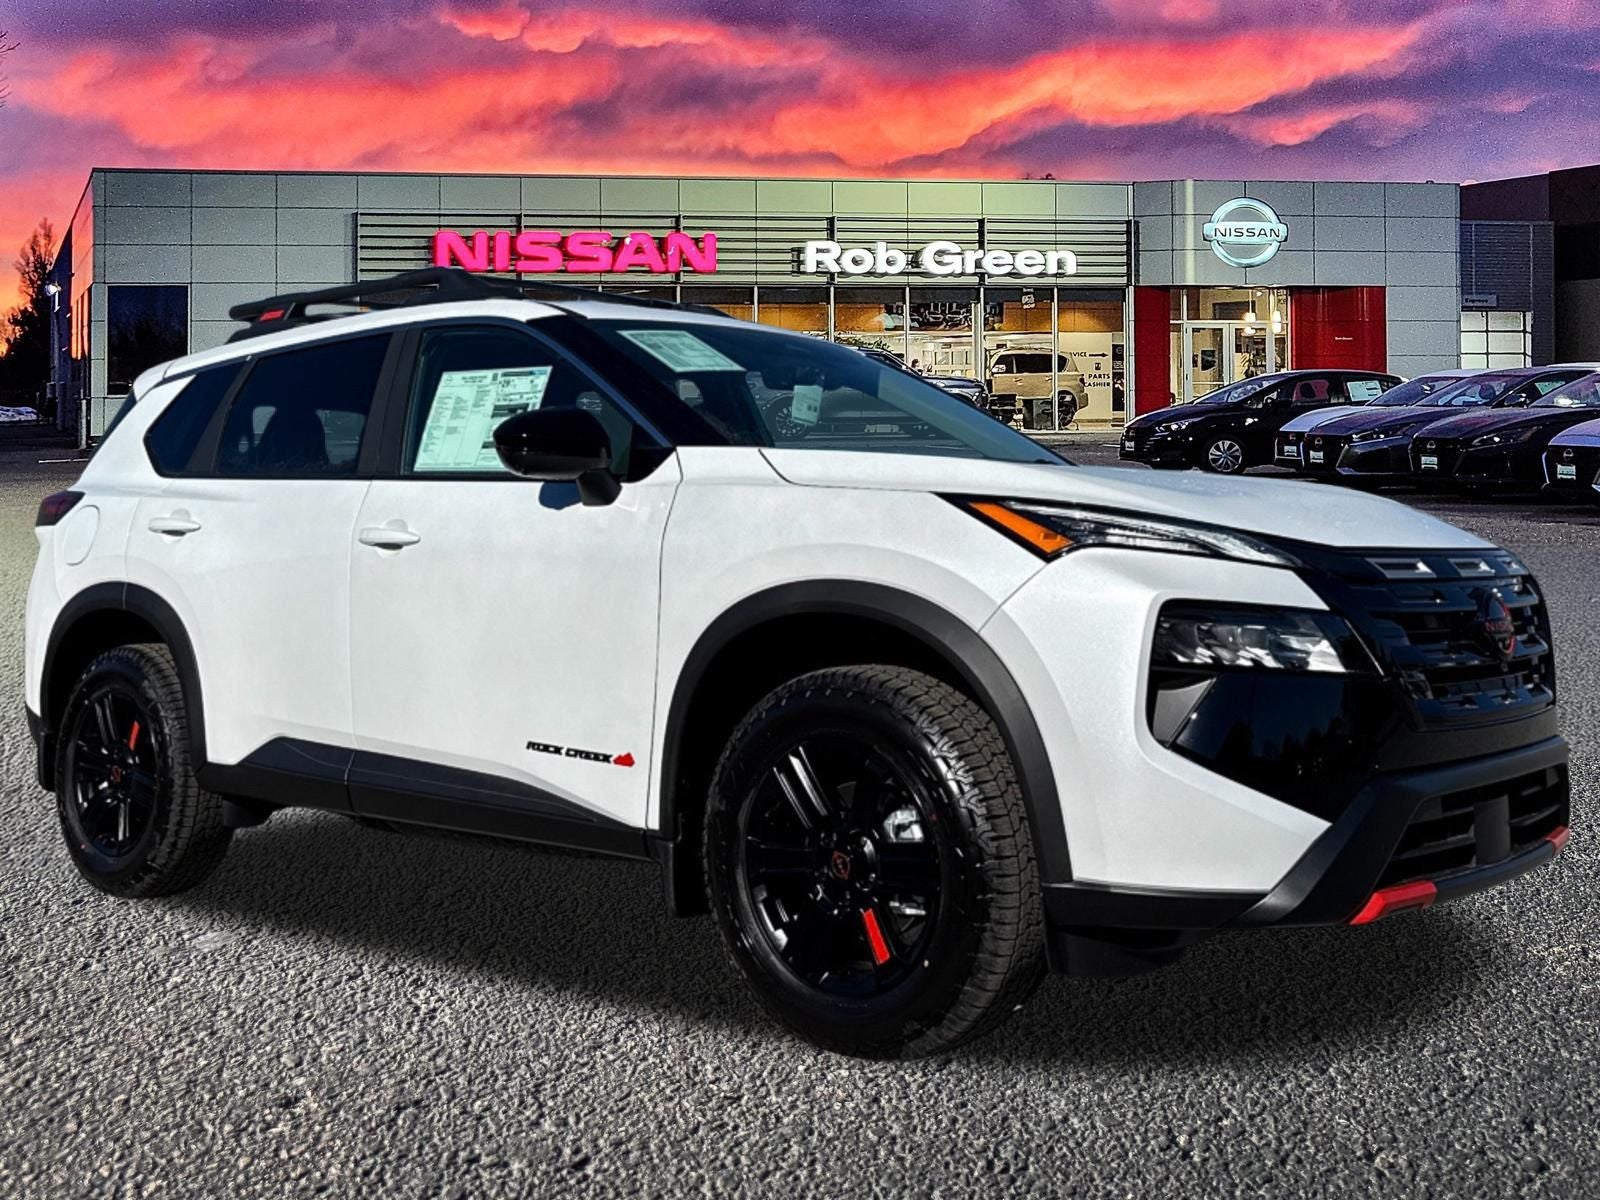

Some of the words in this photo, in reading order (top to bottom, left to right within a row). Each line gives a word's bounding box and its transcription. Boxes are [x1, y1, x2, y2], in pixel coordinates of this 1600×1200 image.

[1214, 228, 1280, 238] NISSAN
[433, 230, 718, 273] NISSAN
[805, 240, 907, 274] Rob
[922, 240, 1077, 275] Green
[526, 740, 564, 756] ROCK
[565, 747, 613, 764] CREEK
